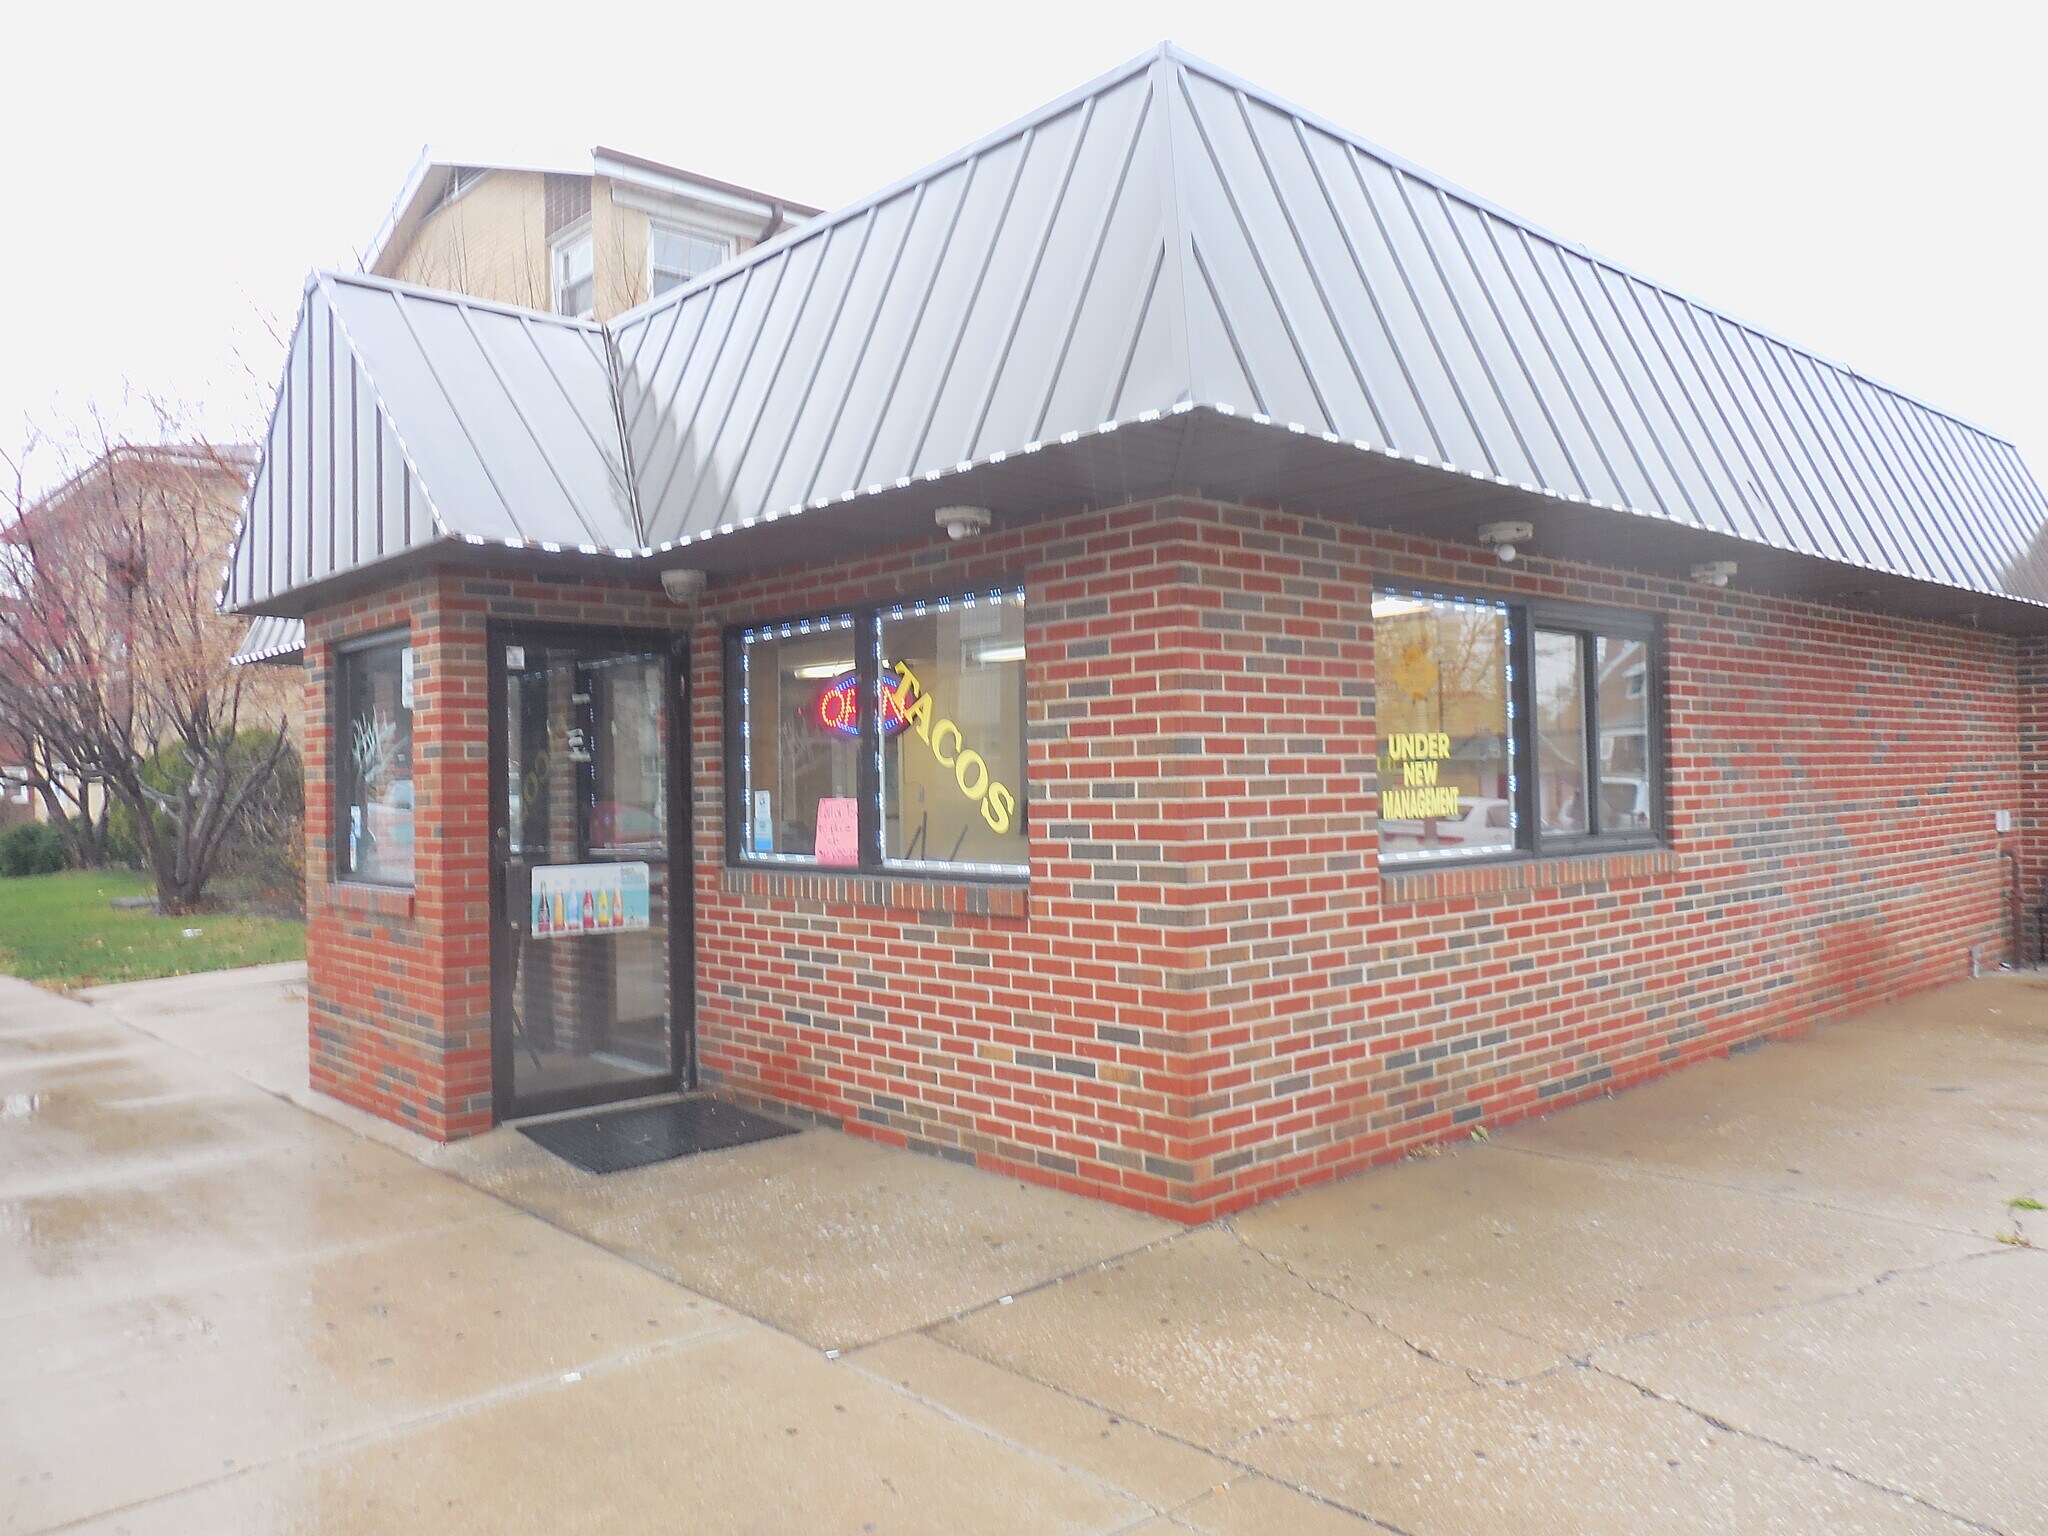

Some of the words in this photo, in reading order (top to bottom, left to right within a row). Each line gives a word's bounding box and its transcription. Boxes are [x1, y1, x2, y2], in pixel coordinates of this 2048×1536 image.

[892, 661, 1015, 834] TACOS
[1388, 732, 1451, 760] UNDER
[1403, 761, 1438, 787] NEW
[1382, 786, 1459, 821] MANAGEMENT
